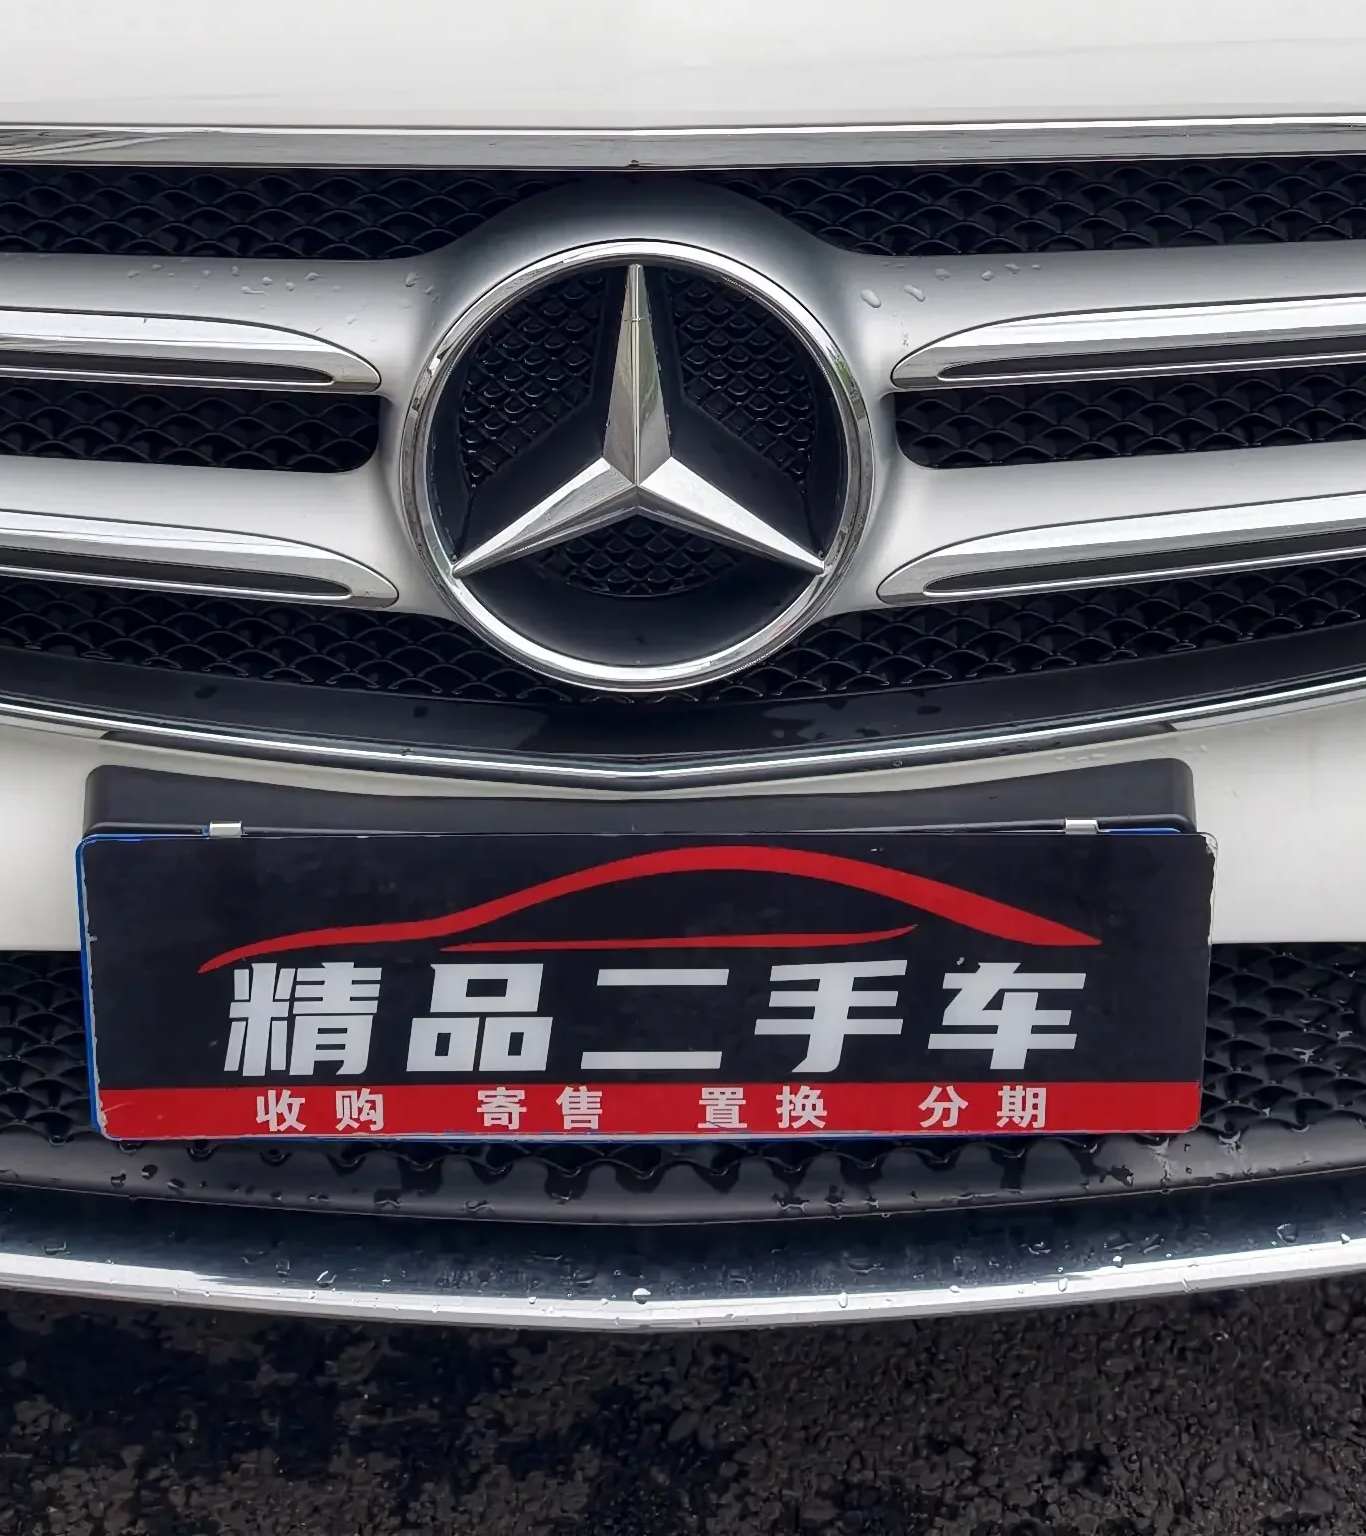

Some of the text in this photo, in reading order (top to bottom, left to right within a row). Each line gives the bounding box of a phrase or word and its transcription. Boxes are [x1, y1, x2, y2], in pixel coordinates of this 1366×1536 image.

[224, 959, 1087, 1077] 精品二手车
[256, 1085, 1047, 1132] 收购 寄售 置换 分期
